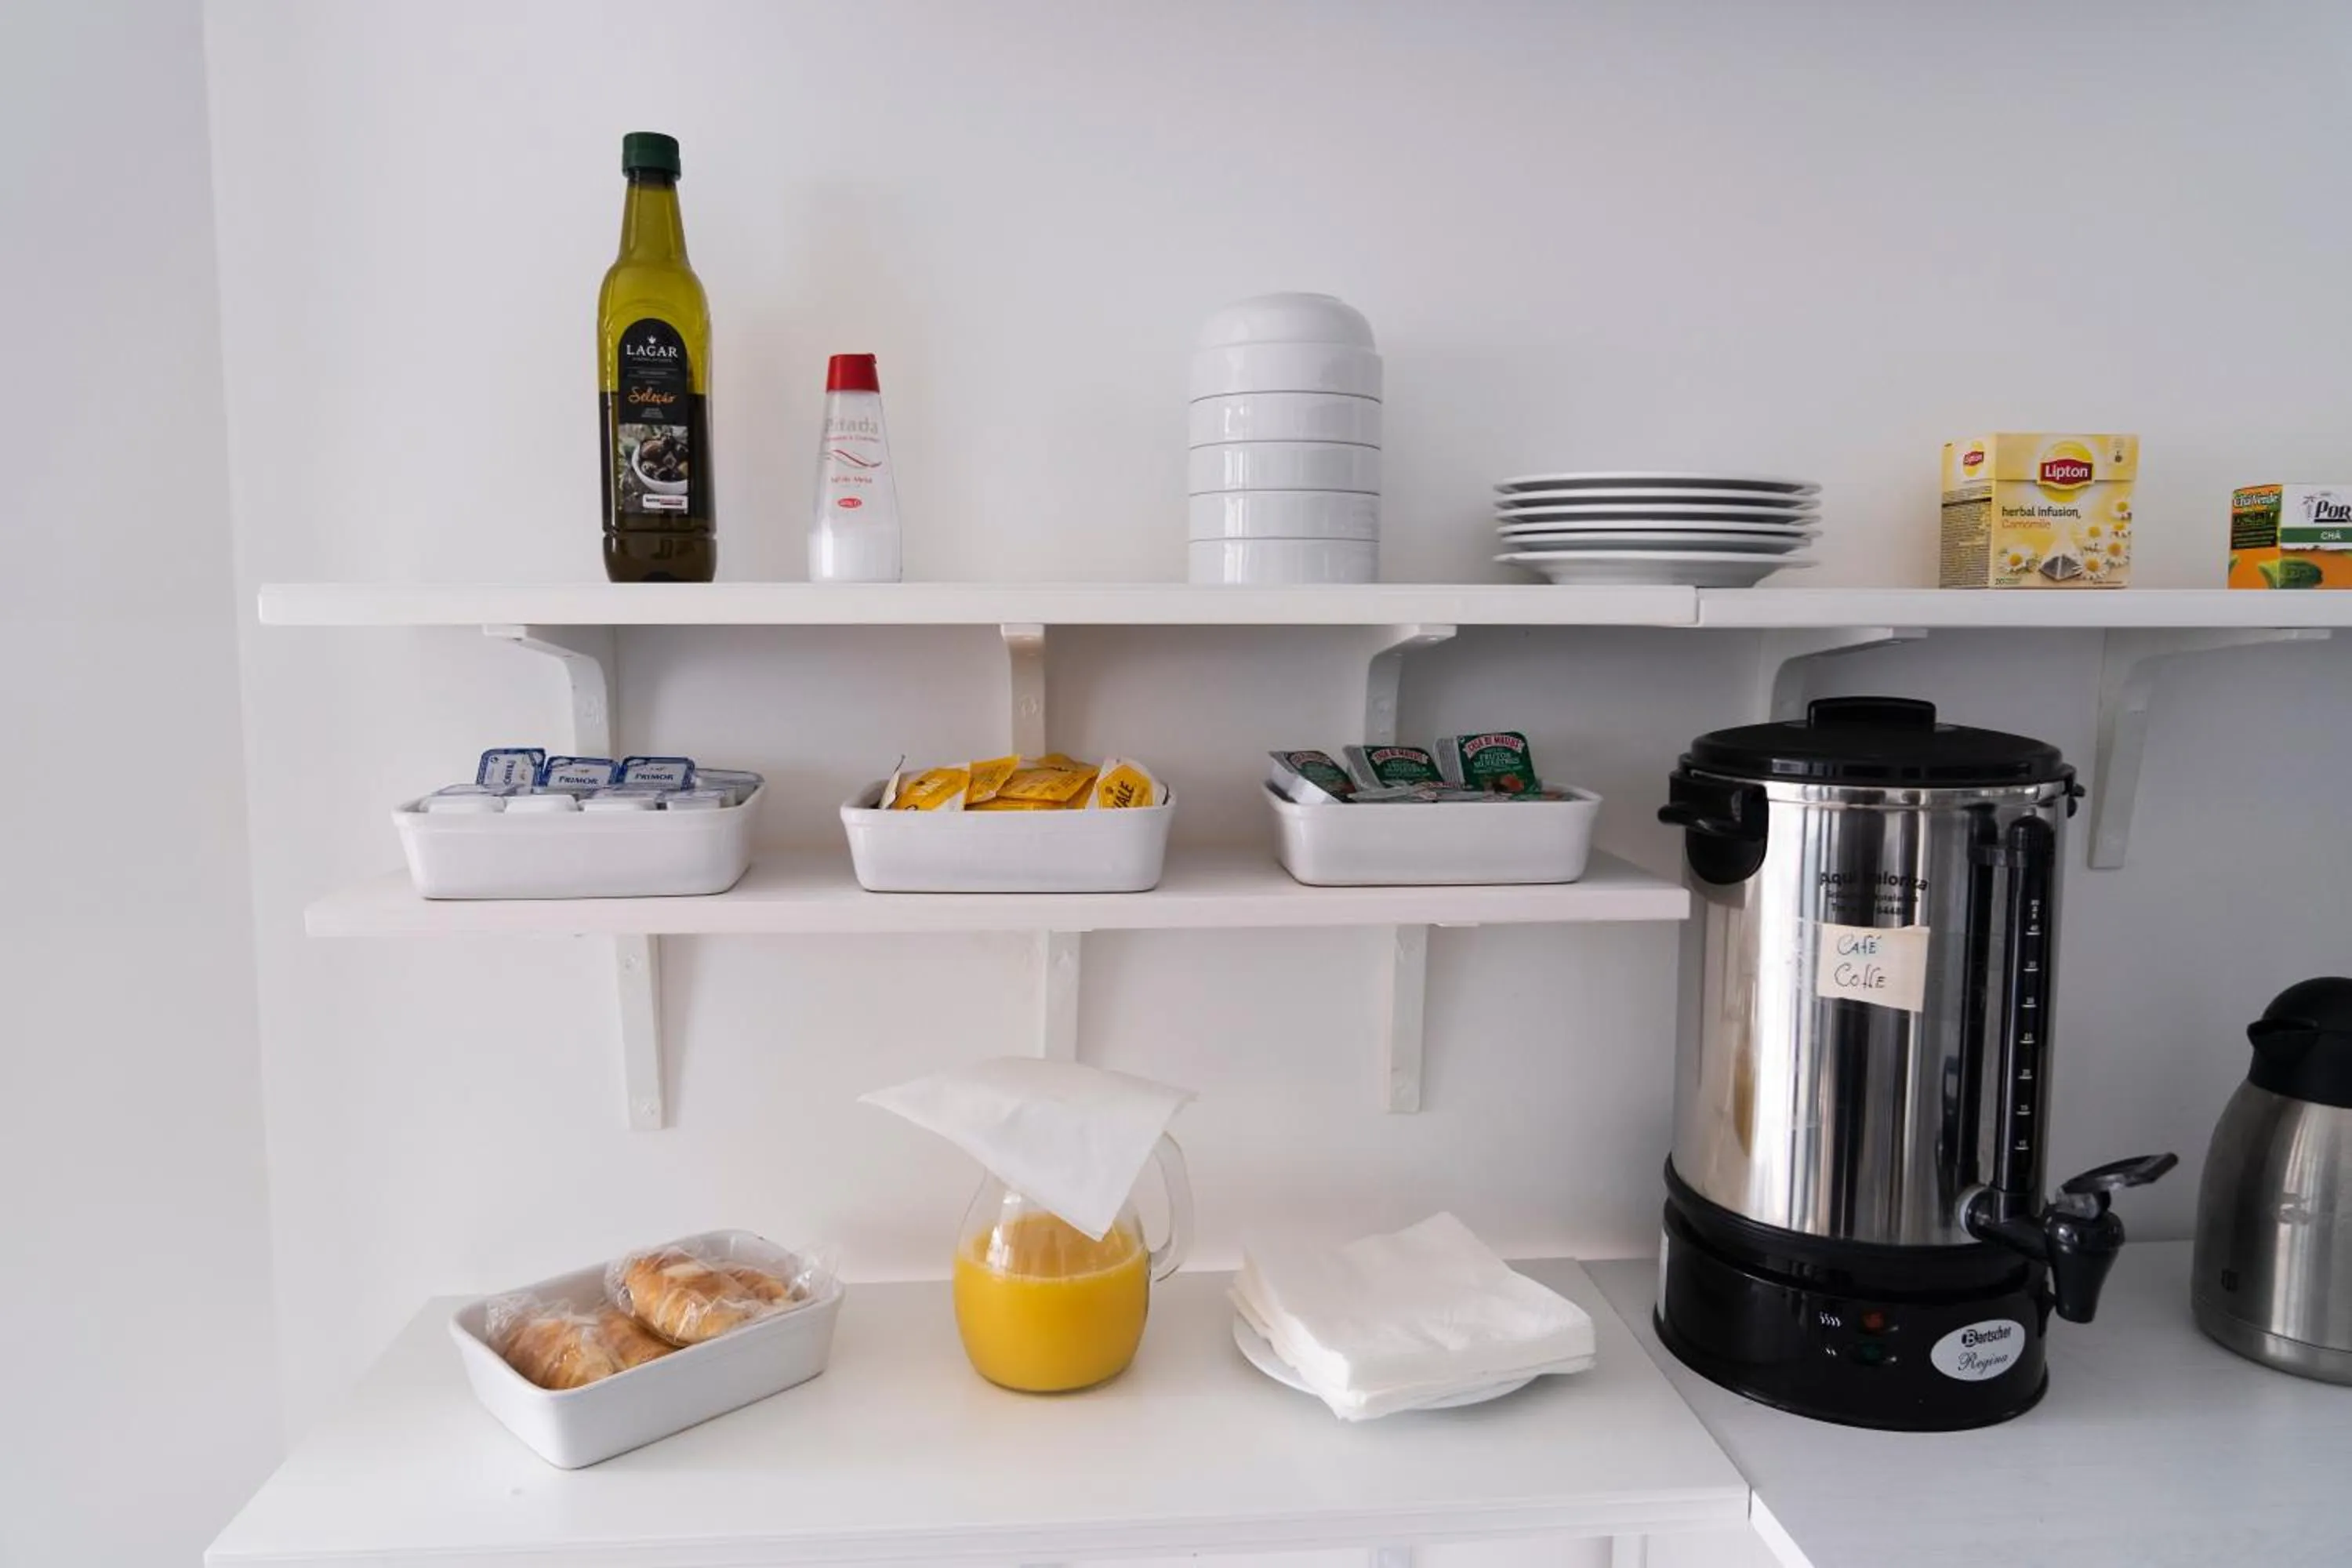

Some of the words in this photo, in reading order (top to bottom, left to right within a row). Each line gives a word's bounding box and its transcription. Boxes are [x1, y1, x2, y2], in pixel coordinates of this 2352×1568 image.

[626, 344, 678, 358] LAGAR
[2045, 465, 2089, 479] Lipton
[2002, 506, 2035, 517] herbal
[2320, 530, 2342, 540] CHÁ
[558, 775, 599, 785] PRIMOR
[1962, 1325, 2012, 1348] Bartscher
[1958, 1352, 2009, 1375] Regina
